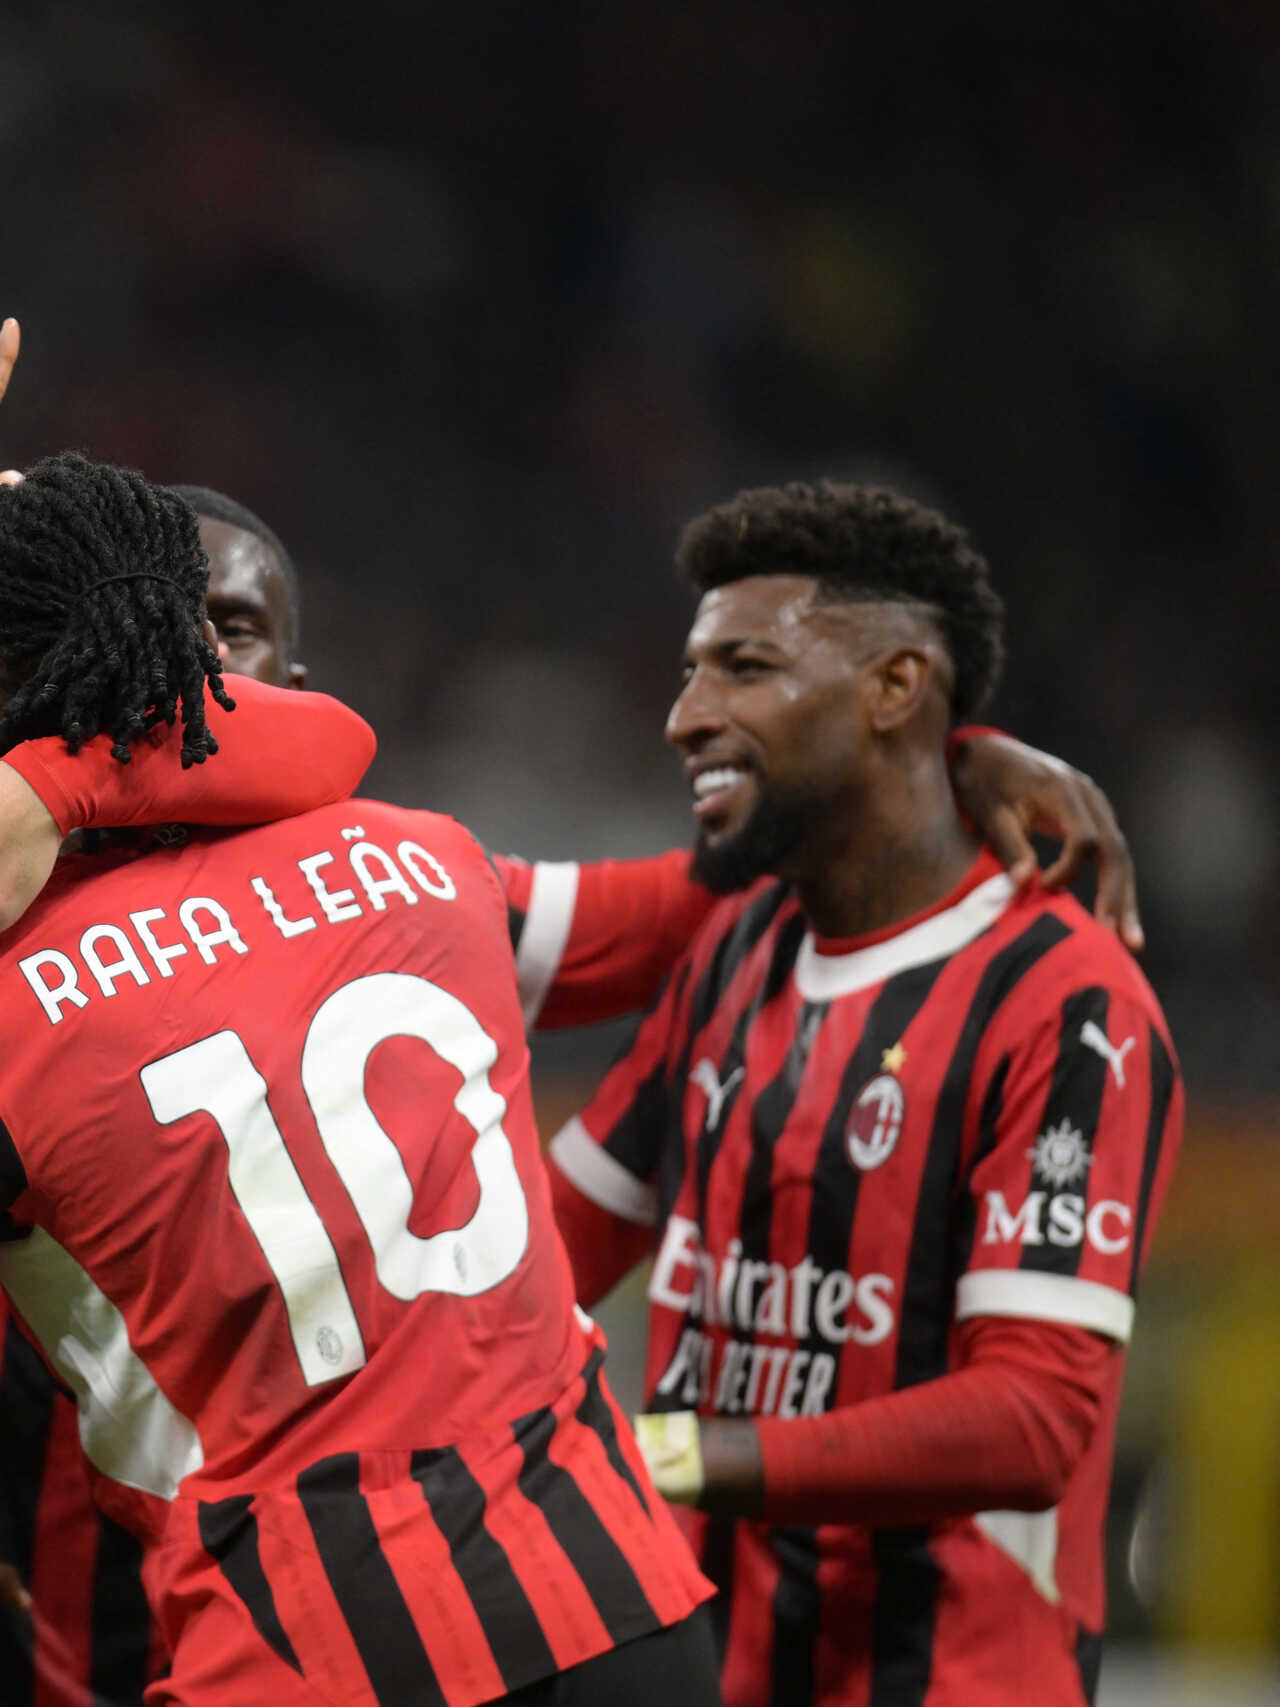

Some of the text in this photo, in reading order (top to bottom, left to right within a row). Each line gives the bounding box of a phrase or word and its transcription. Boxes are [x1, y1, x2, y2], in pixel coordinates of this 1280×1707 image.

[18, 825, 457, 1026] RAFA LEÃO
[140, 972, 530, 1388] 10
[982, 1190, 1131, 1255] MSC
